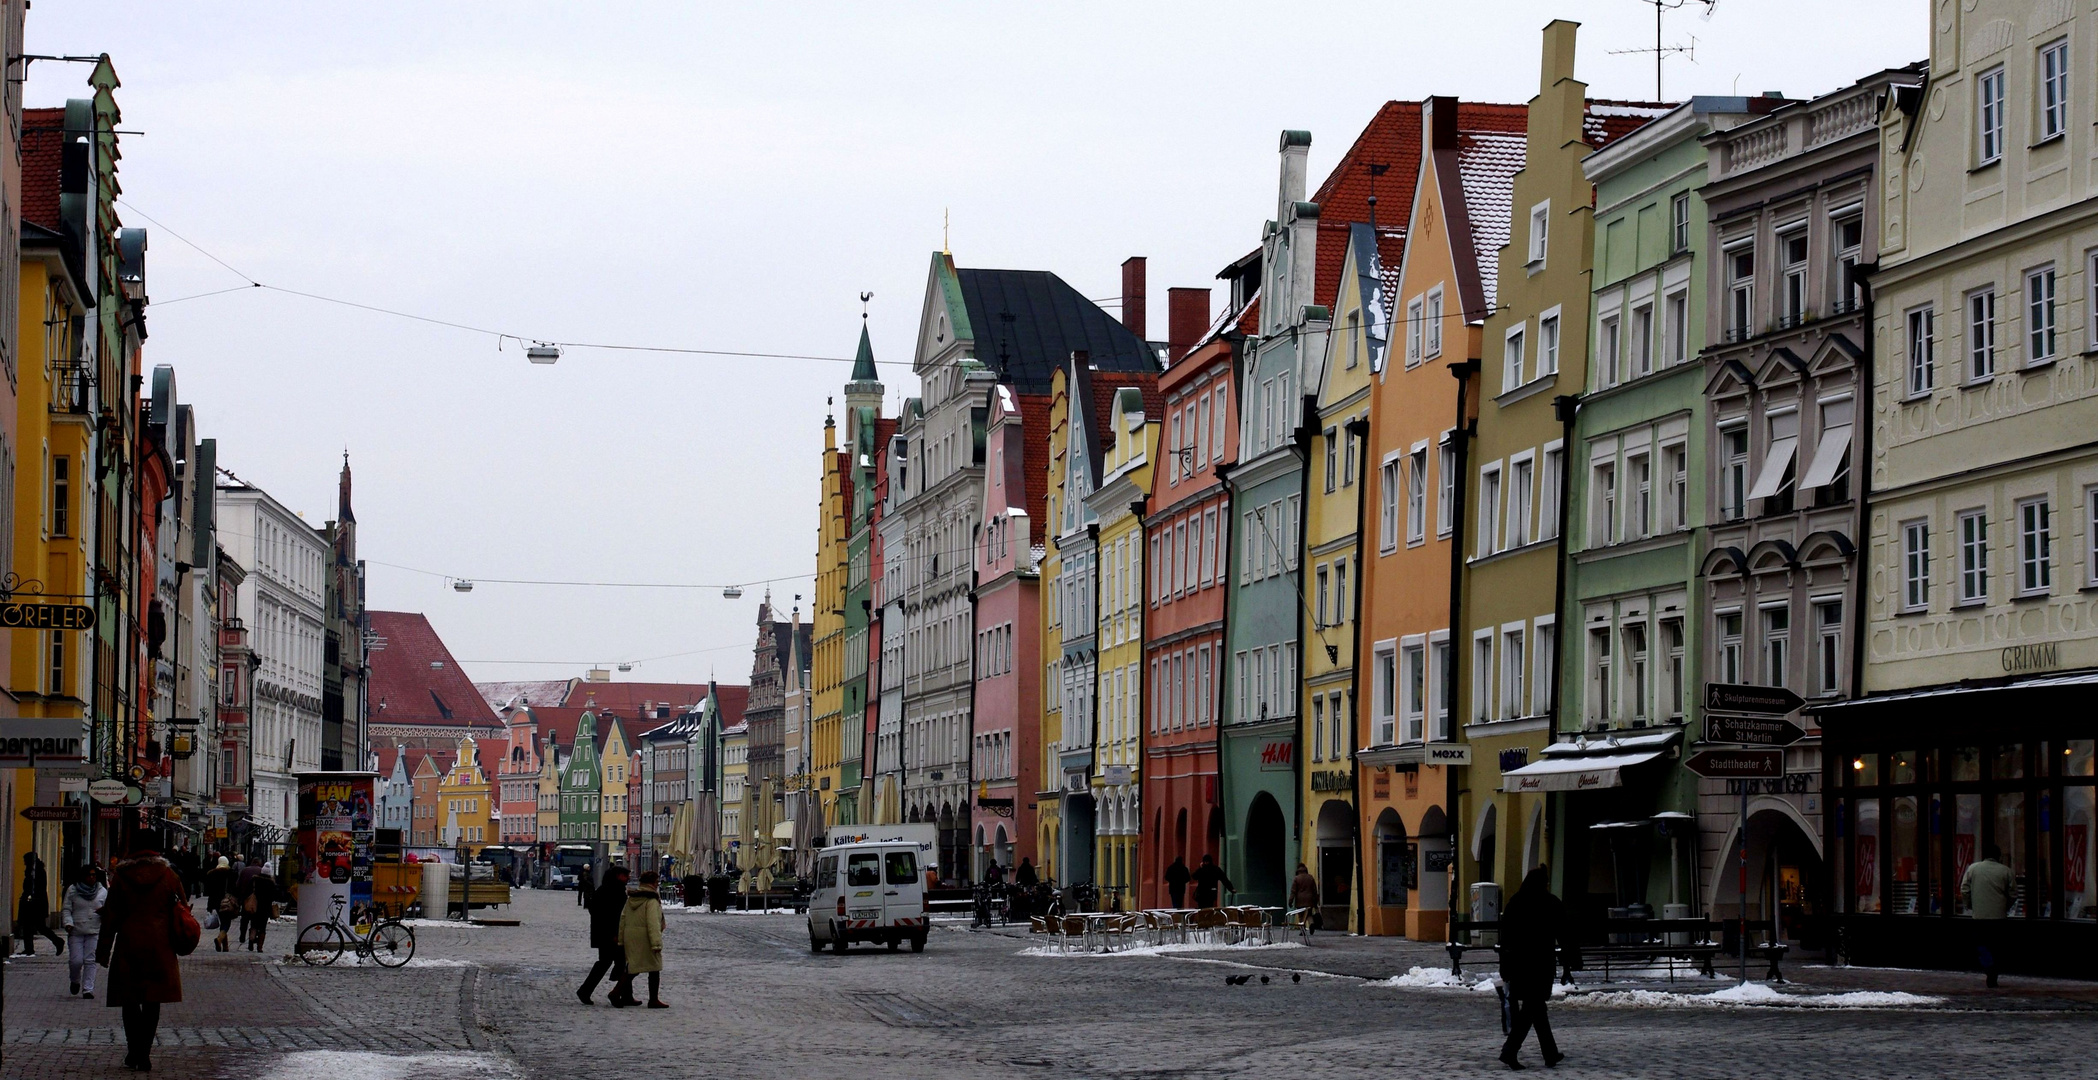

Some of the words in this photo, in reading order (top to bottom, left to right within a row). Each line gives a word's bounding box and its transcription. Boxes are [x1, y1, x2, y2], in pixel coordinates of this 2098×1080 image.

[0, 603, 86, 628] ÖRFLER
[2001, 642, 2057, 672] GRIMM
[1724, 693, 1786, 706] Skulpturenmuseum
[1725, 718, 1783, 732] Schatzkammer
[1262, 743, 1292, 764] H&M
[1710, 759, 1760, 769] Stadttheater
[1578, 774, 1600, 789] Chocolat
[317, 785, 352, 802] EAV
[30, 809, 68, 817] Stadttheater
[834, 835, 856, 846] Kälte
